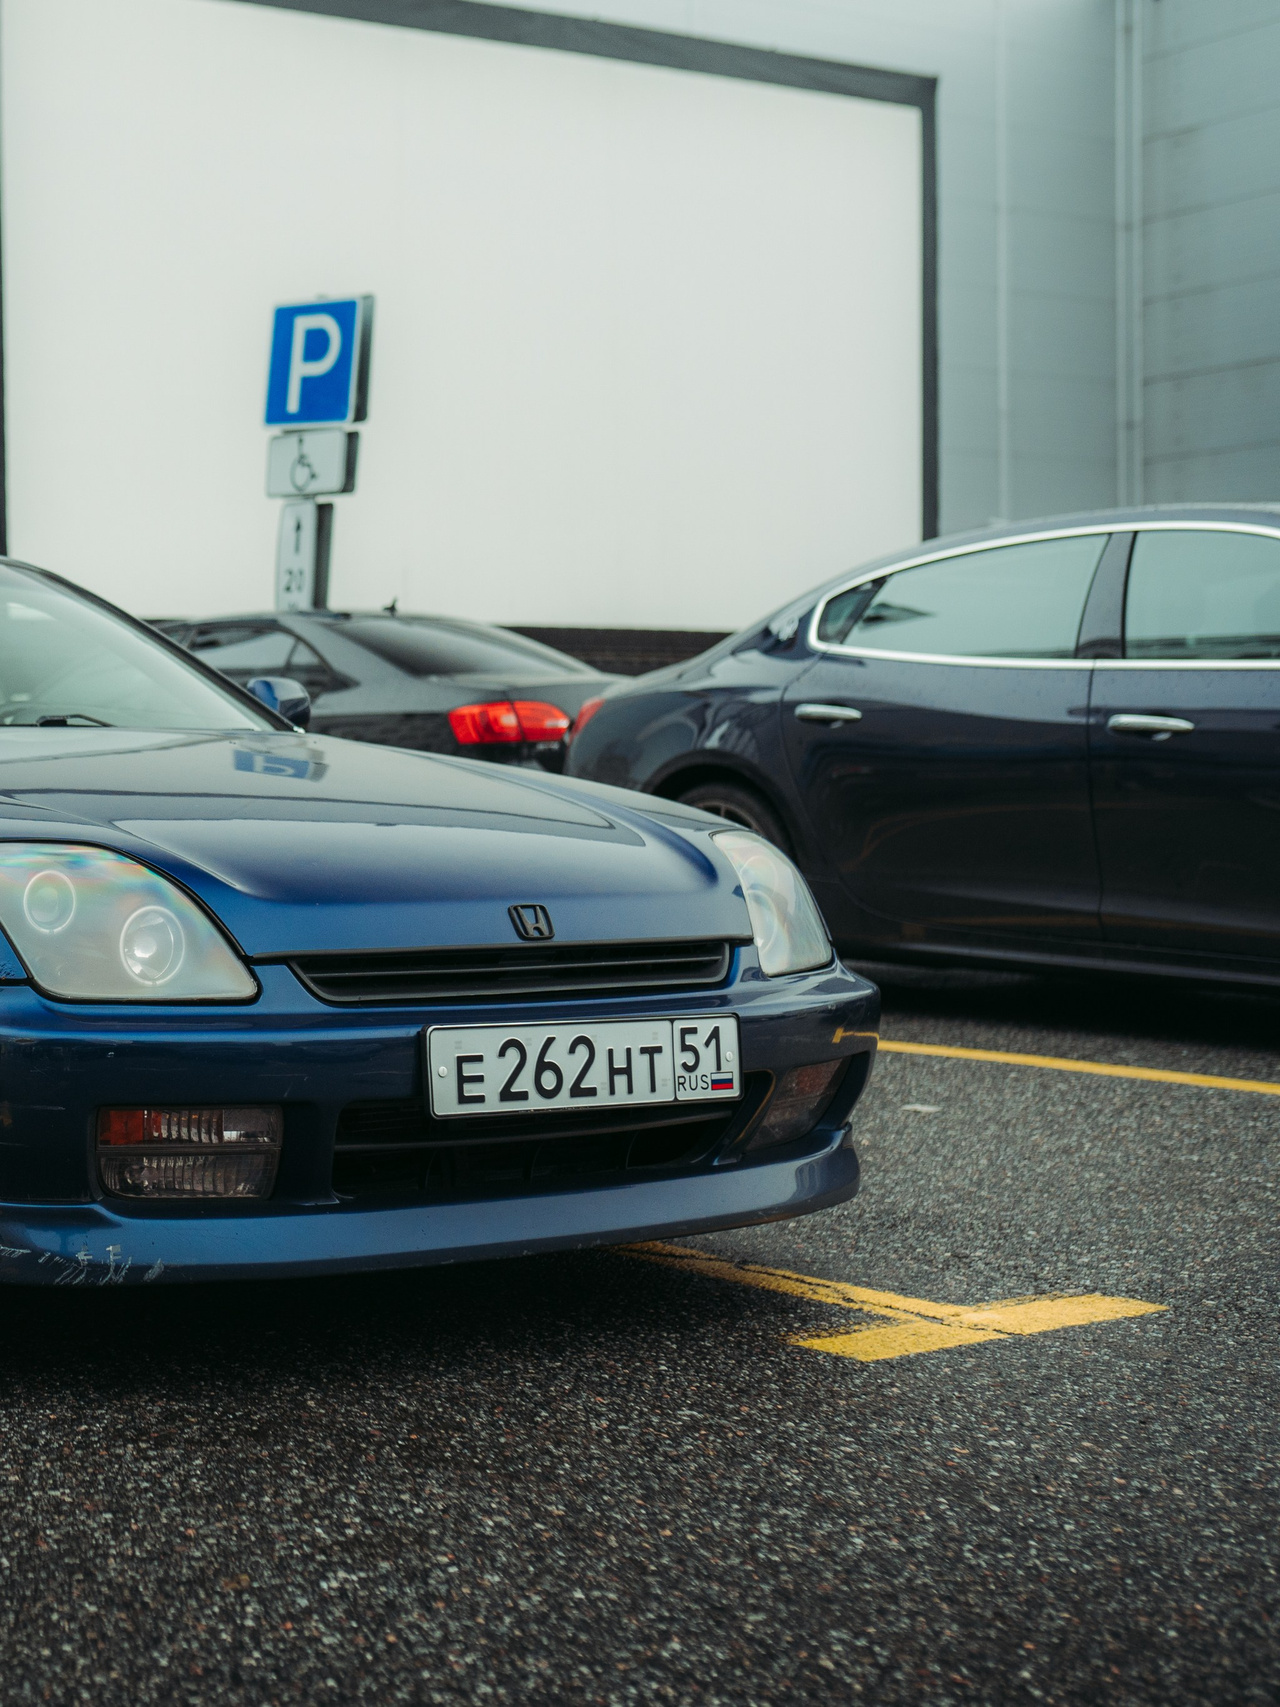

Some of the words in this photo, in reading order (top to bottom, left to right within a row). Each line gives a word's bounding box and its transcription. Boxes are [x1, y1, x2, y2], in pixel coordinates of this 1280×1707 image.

[286, 313, 342, 414] P
[679, 1025, 722, 1074] 51
[677, 1074, 710, 1092] RUS
